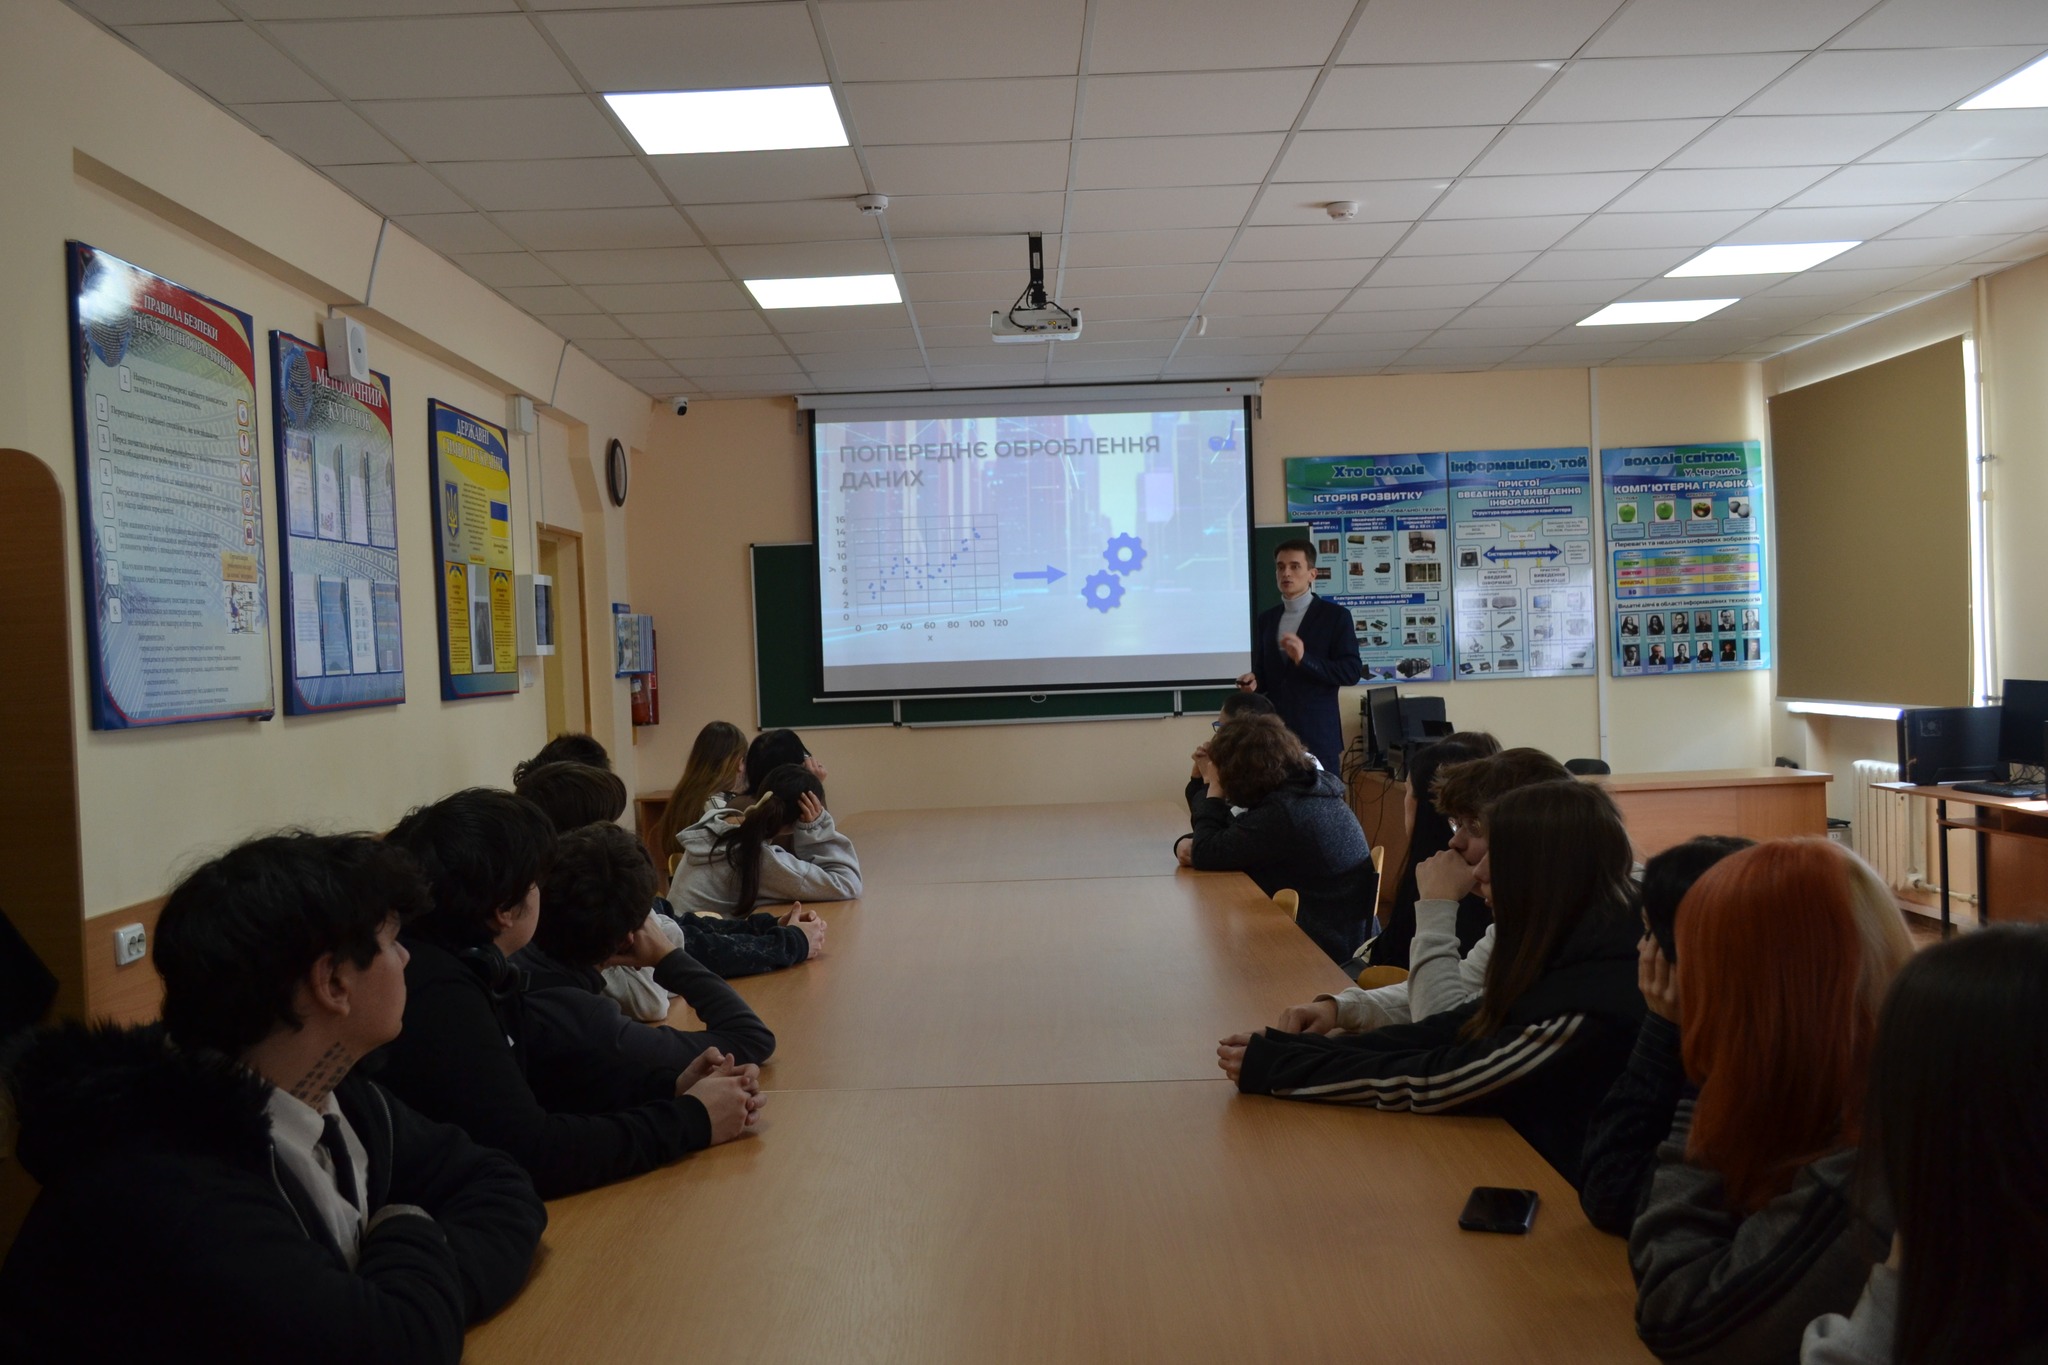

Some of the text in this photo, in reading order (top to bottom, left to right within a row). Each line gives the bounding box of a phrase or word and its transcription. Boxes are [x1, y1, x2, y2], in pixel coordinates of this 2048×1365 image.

[144, 295, 218, 341] ПРАВИЛА БЕЗПЕКИ
[328, 400, 372, 432] КУТОЧОК
[456, 418, 490, 445] ДЕРЖАВНІ
[840, 436, 1160, 463] ПОПЕРЕДНЄ ОБРОБЛЕННЯ
[1559, 456, 1588, 469] той
[1624, 451, 1740, 466] володіє світом.
[1333, 464, 1424, 478] Хто володіє
[1683, 467, 1741, 478] У. Черчиль
[840, 470, 925, 492] ДАНИХ
[1498, 479, 1540, 488] ПРИСТОЇ
[1702, 479, 1754, 490] ГРАФІКА
[1314, 491, 1423, 504] ІСТОРІЯ РОЗВИТКУ
[1523, 487, 1581, 496] ВИВЕДЕННЯ
[1489, 497, 1549, 507] ІНФОРМАЦІЇ
[1687, 537, 1721, 546] цифрових
[900, 622, 912, 630] 40
[924, 621, 936, 629] 60
[948, 620, 960, 628] 80
[969, 620, 985, 628] 100
[993, 619, 1008, 627] 120
